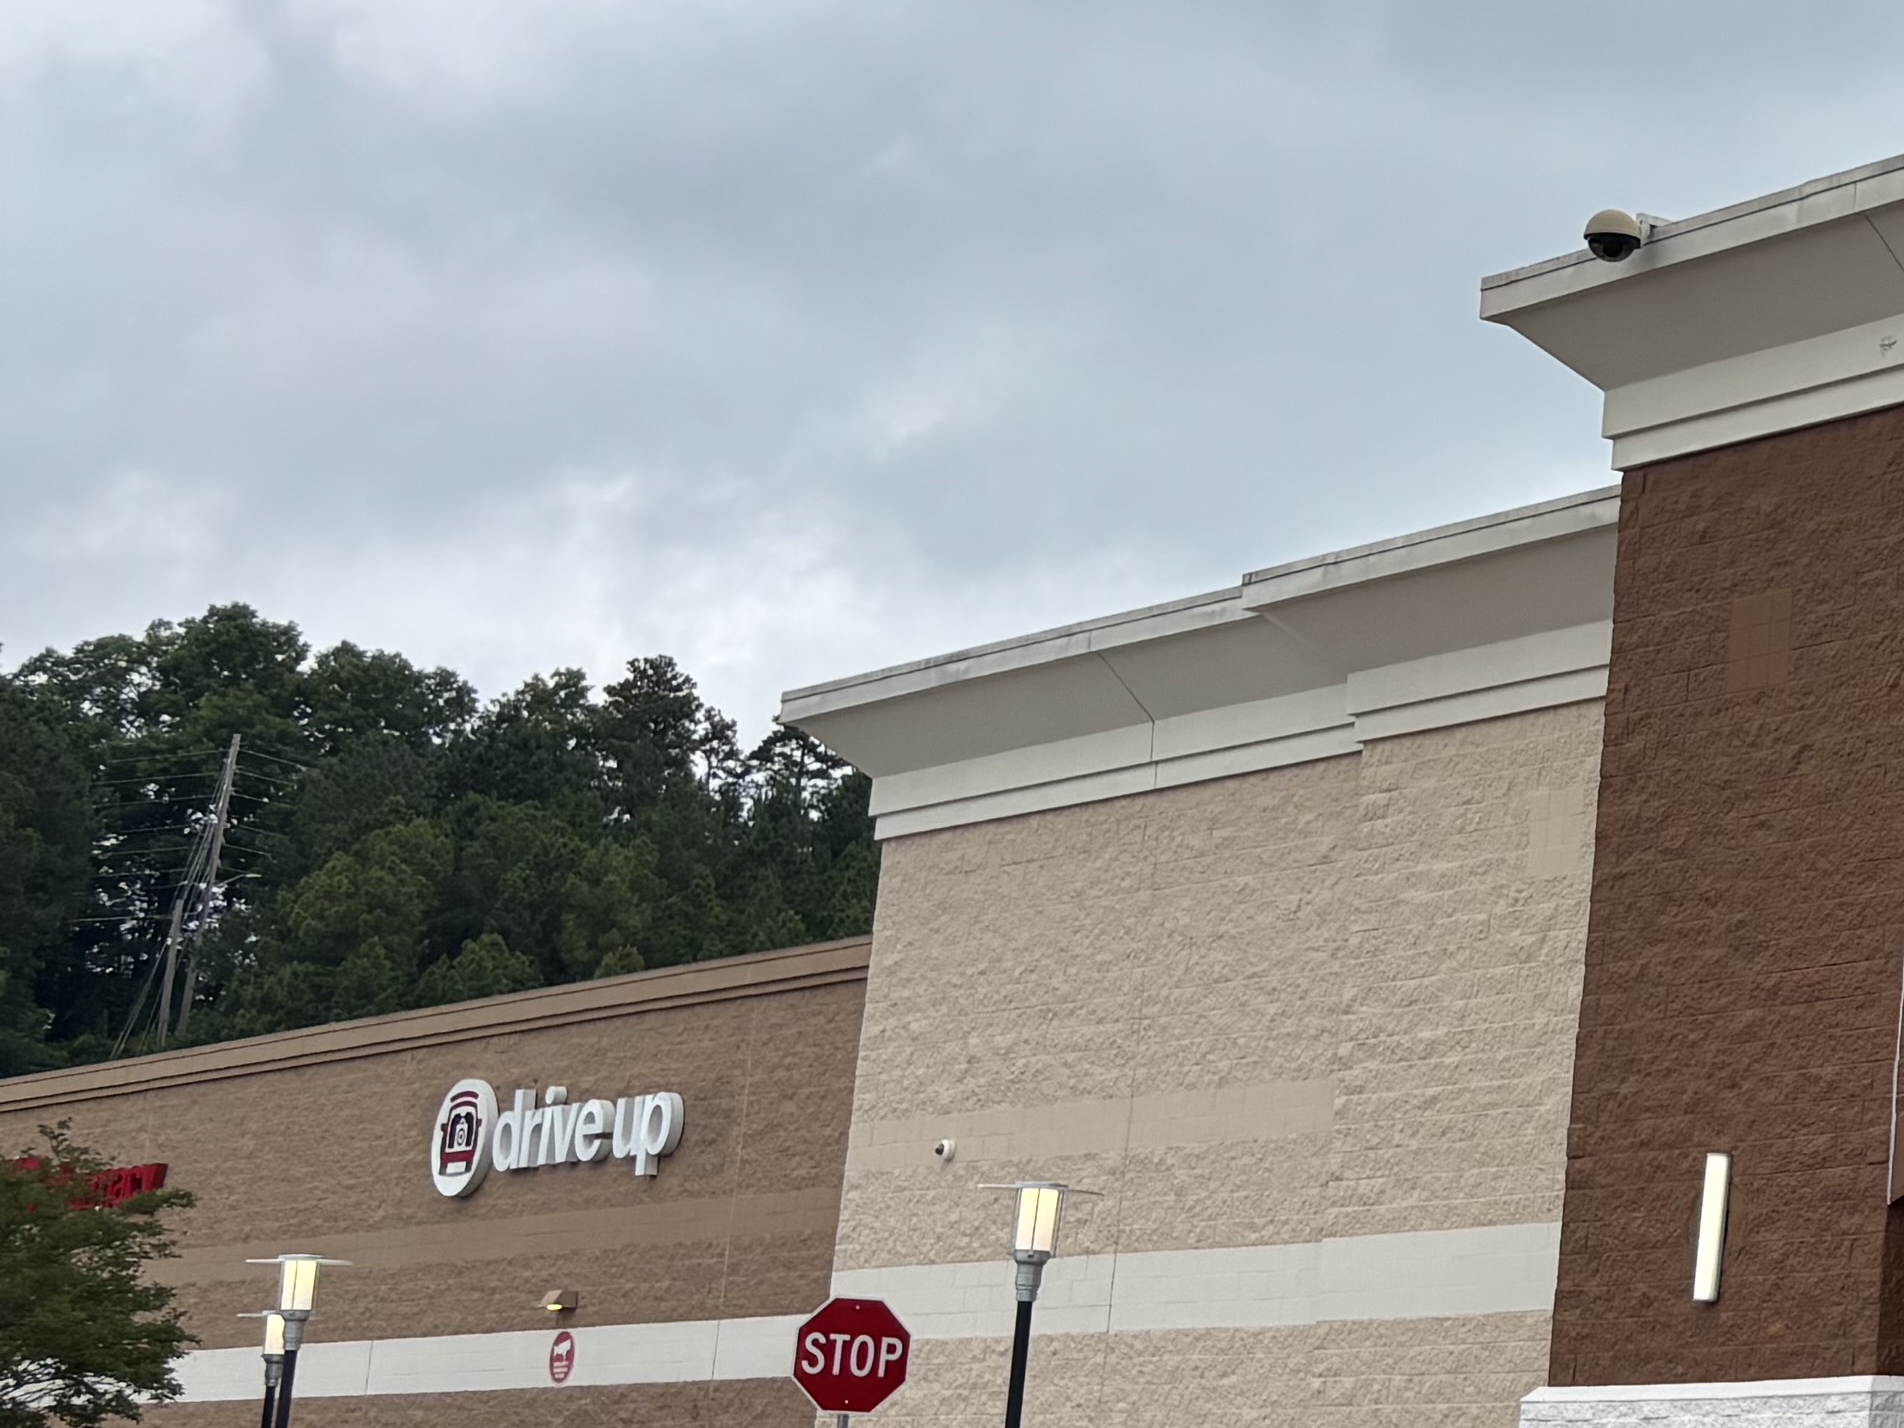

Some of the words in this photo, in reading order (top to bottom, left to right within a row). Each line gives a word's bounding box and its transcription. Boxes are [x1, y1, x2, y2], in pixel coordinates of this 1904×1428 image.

[492, 1086, 615, 1172] drive
[612, 1091, 684, 1176] up
[801, 1331, 903, 1378] STOP
